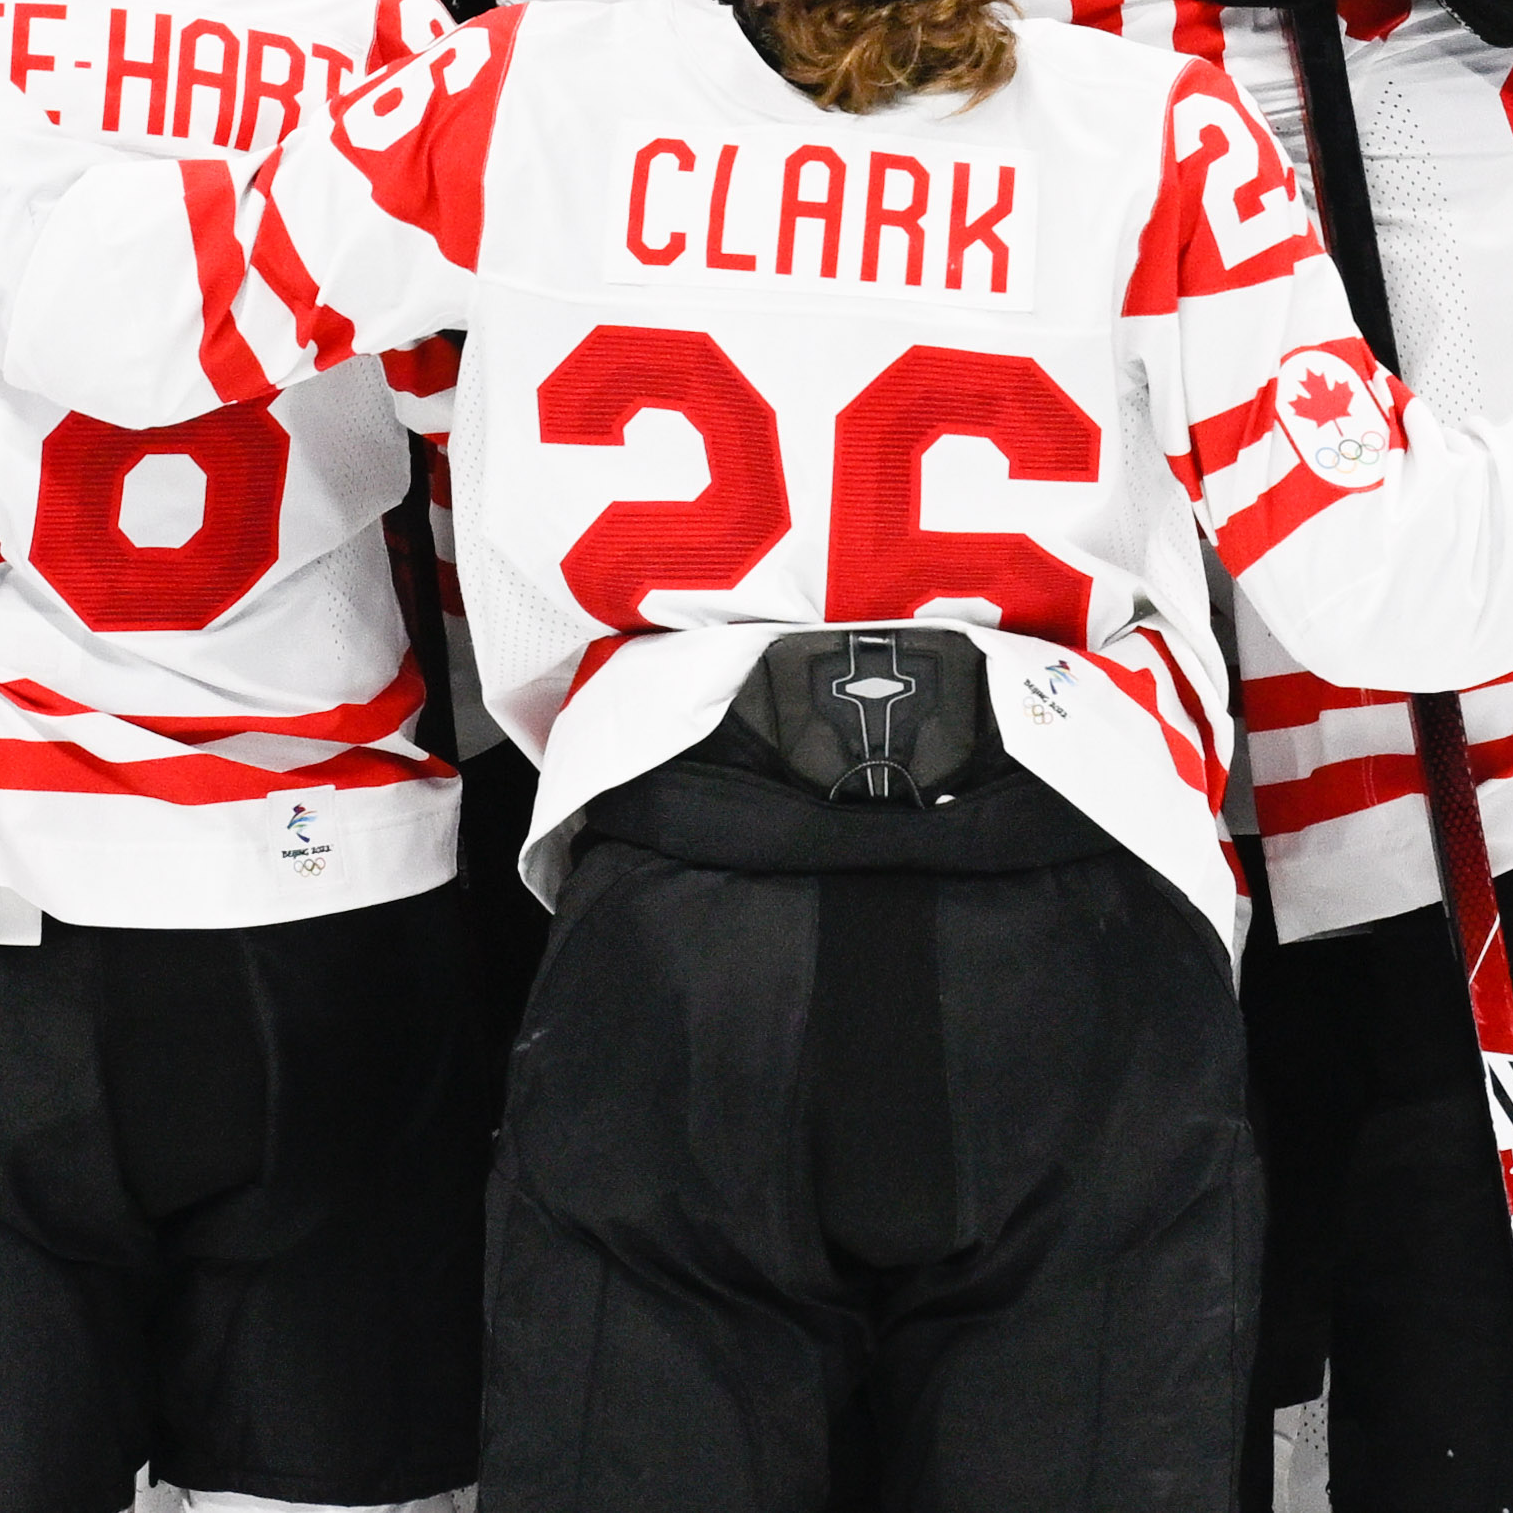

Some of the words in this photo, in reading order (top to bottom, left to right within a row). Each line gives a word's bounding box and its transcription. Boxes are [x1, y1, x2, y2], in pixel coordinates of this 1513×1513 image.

[625, 137, 1017, 295] CLARK
[536, 323, 1103, 651] 26
[281, 848, 310, 859] BEIJING
